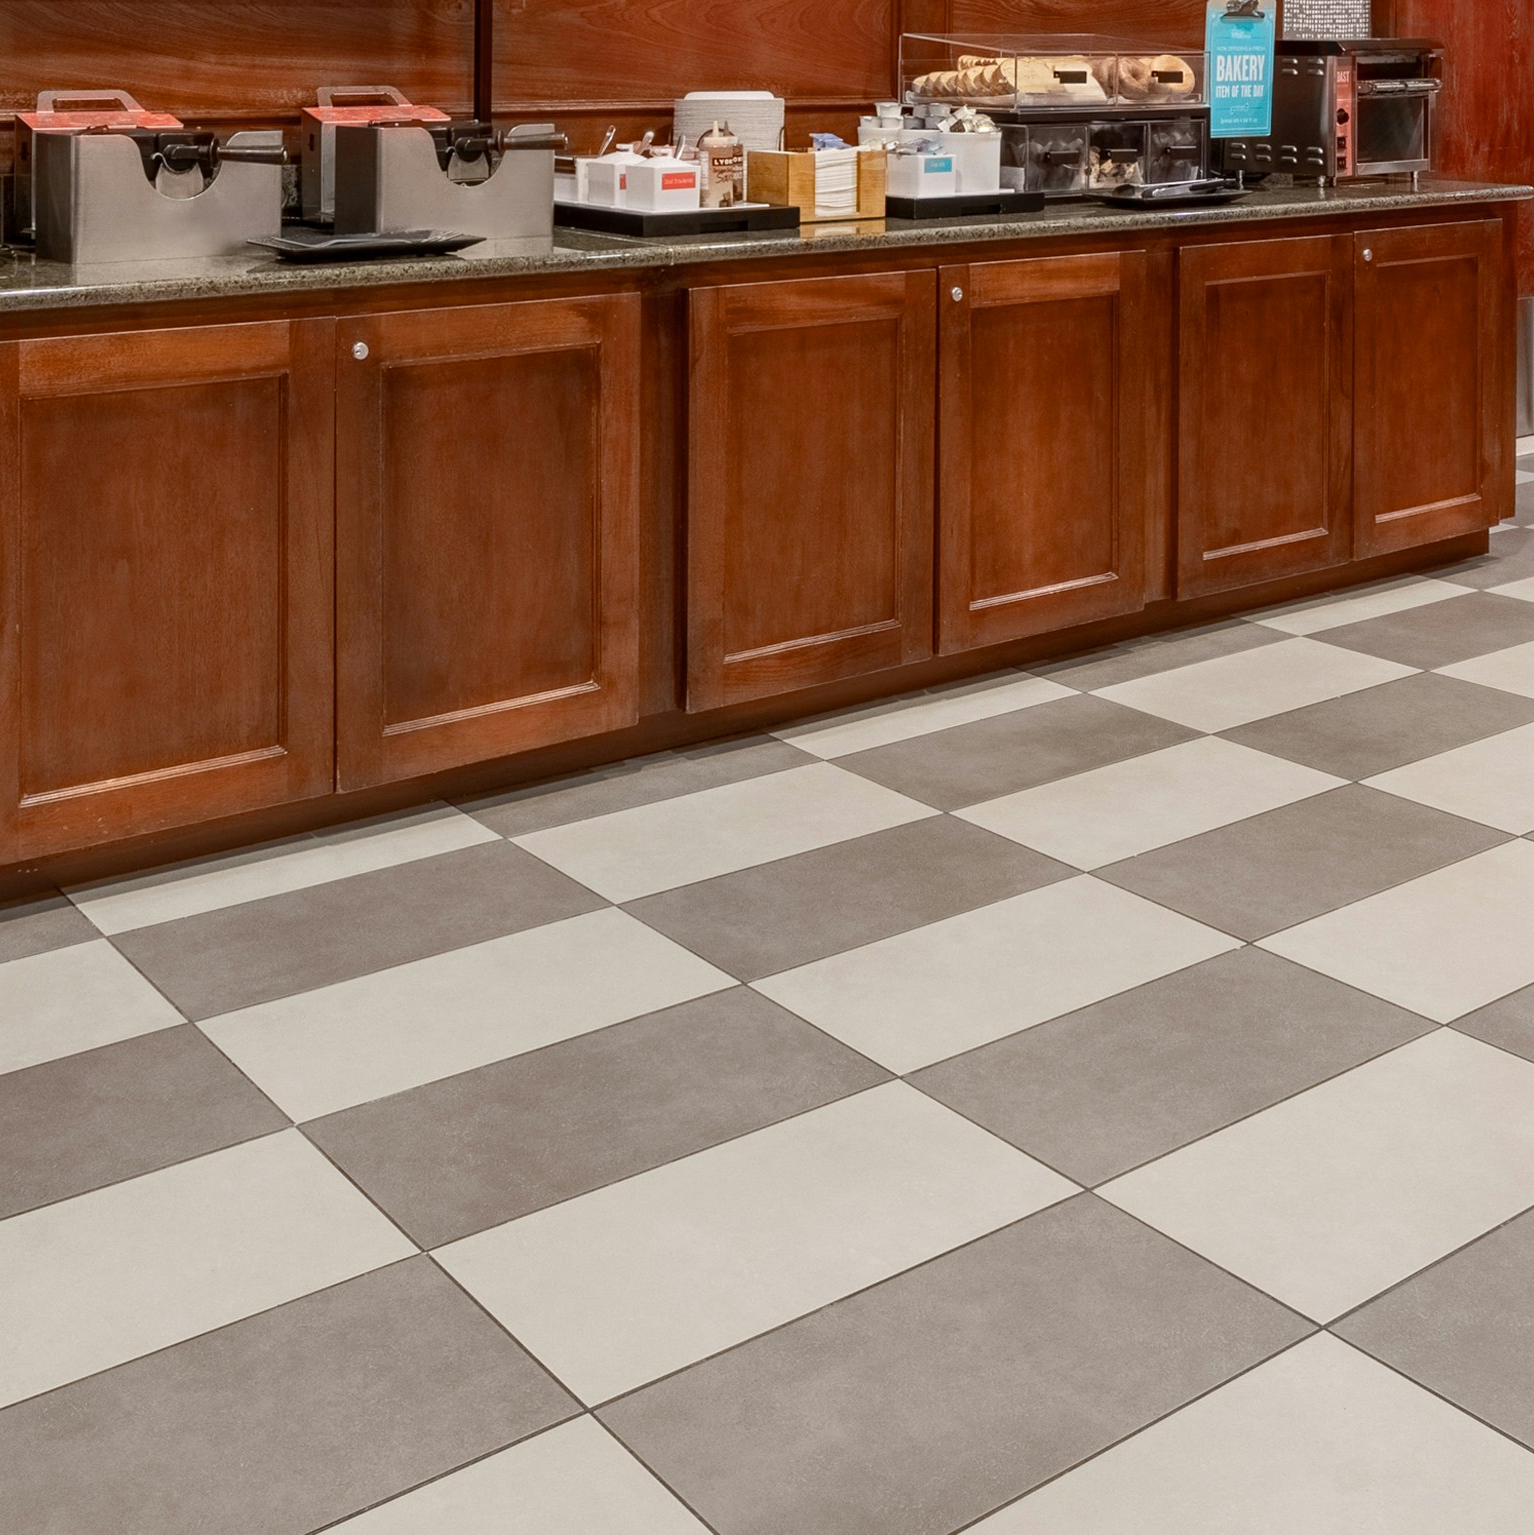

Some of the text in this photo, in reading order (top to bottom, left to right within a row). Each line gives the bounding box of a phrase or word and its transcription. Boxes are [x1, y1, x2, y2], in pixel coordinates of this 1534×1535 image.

[1216, 55, 1266, 81] BAKERY
[1215, 85, 1264, 98] ITEM OF THE DAY
